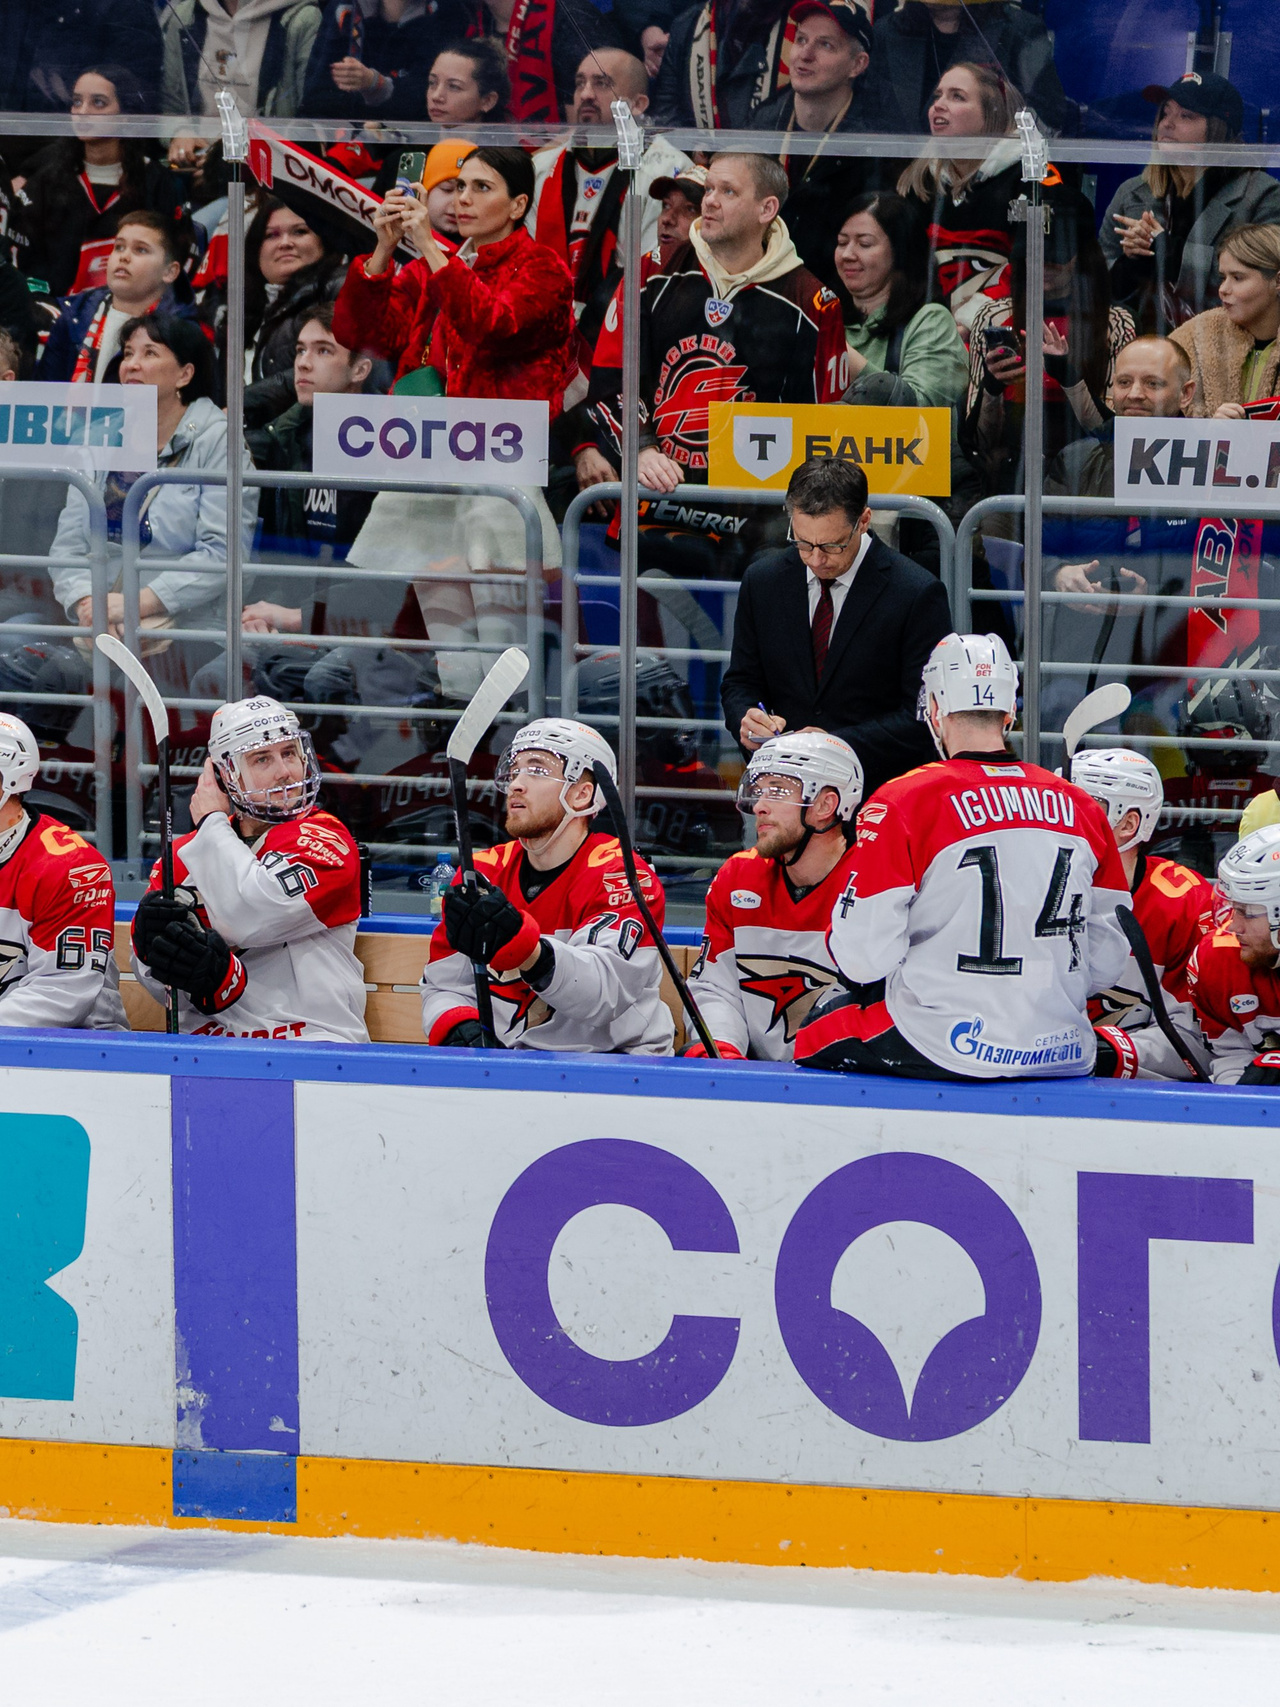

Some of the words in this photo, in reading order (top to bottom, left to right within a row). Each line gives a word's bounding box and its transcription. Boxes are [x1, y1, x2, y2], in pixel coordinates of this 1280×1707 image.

[654, 333, 736, 405] ОМСКИЙ
[827, 351, 849, 394] 10
[805, 434, 924, 466] БАНК
[975, 663, 992, 671] FON
[972, 684, 995, 706] 14
[949, 785, 1074, 831] IGUMNOV
[956, 845, 1087, 976] 14
[55, 926, 112, 974] 65
[1035, 1034, 1061, 1047] СЕТЬ
[1062, 1027, 1081, 1040] АЗС
[484, 1137, 1280, 1447] сог
